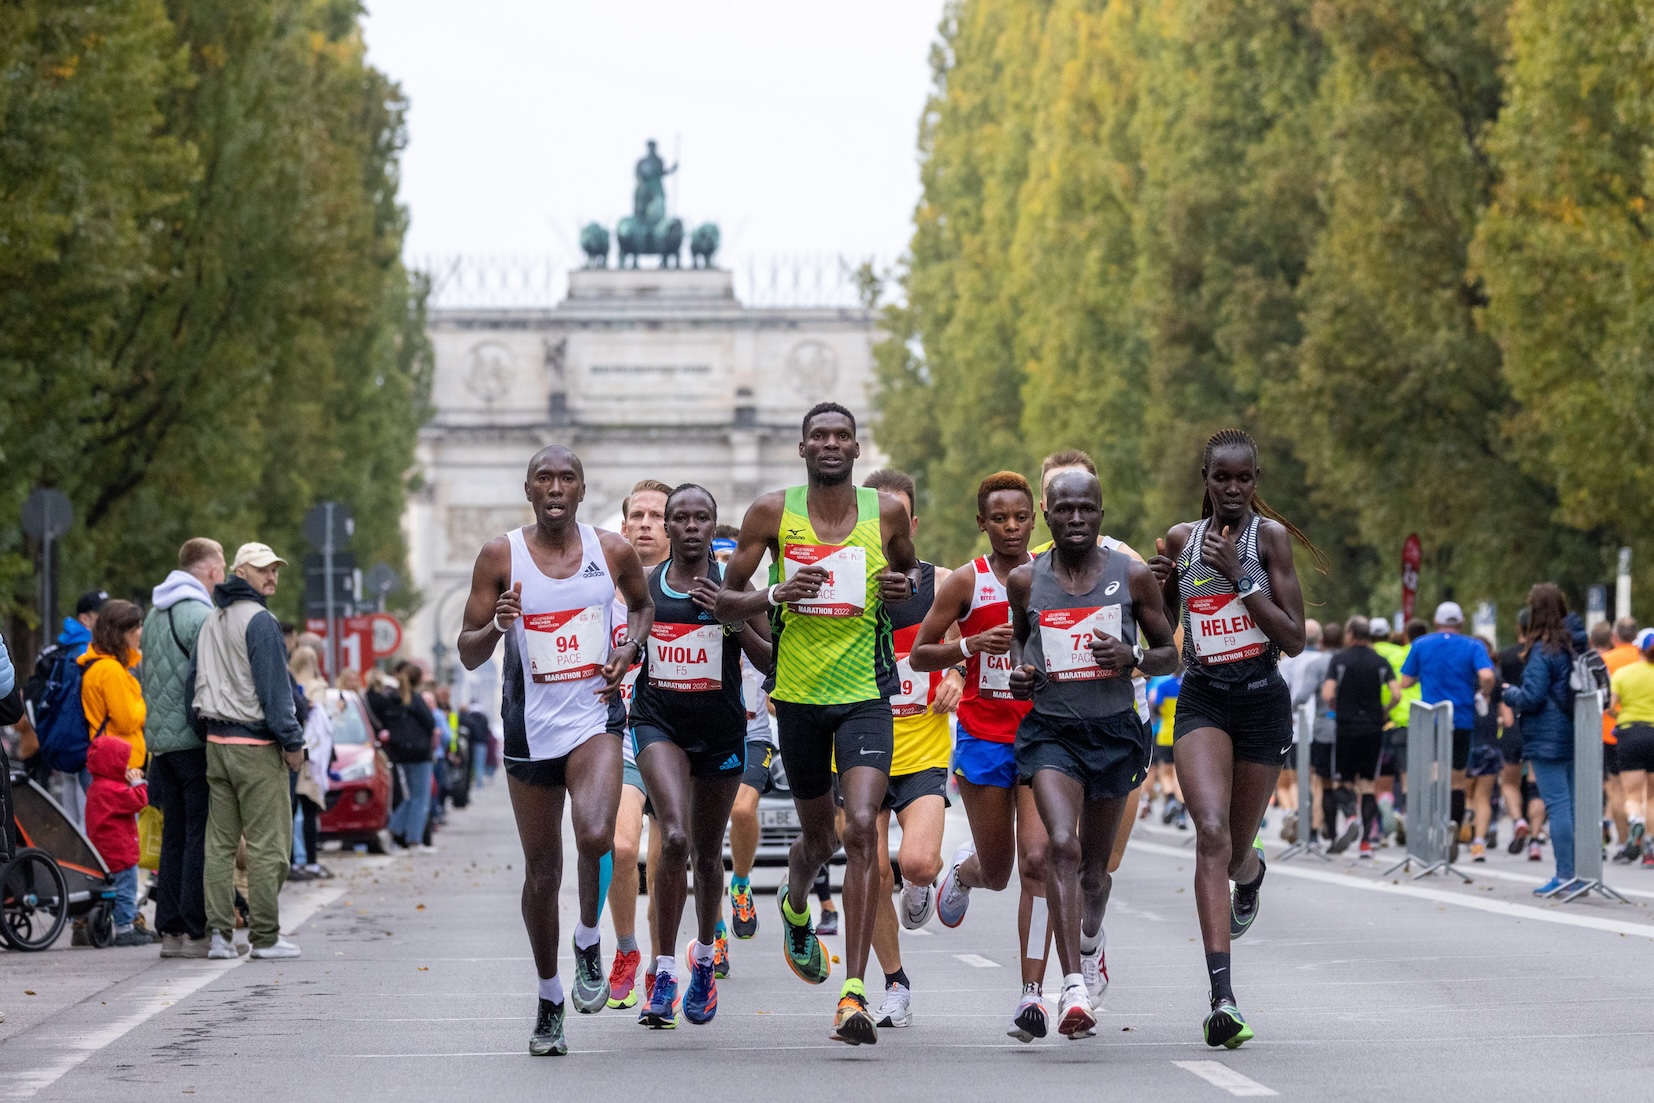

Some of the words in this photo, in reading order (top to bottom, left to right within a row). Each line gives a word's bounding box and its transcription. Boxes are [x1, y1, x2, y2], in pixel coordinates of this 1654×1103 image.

[583, 571, 605, 579] adidas
[819, 589, 836, 600] ACE
[798, 606, 833, 615] MARATHON
[1201, 614, 1256, 637] HELEN
[556, 634, 579, 653] 94
[1070, 633, 1093, 651] 73
[1223, 636, 1236, 646] F9
[557, 653, 581, 666] PACE
[657, 645, 708, 664] VIOLA
[1207, 651, 1243, 663] MARATHON
[1244, 647, 1260, 657] 2022
[532, 661, 538, 670] A
[1046, 658, 1051, 667] A
[650, 664, 654, 673] A
[676, 666, 687, 676] F5
[544, 670, 581, 682] MARATHON
[981, 675, 988, 684] A
[1058, 670, 1096, 680] MARATHON
[657, 680, 691, 690] MARATHON
[692, 682, 708, 690] 2022
[901, 679, 913, 695] 9
[992, 690, 1014, 699] MARA
[719, 761, 742, 771] adidas
